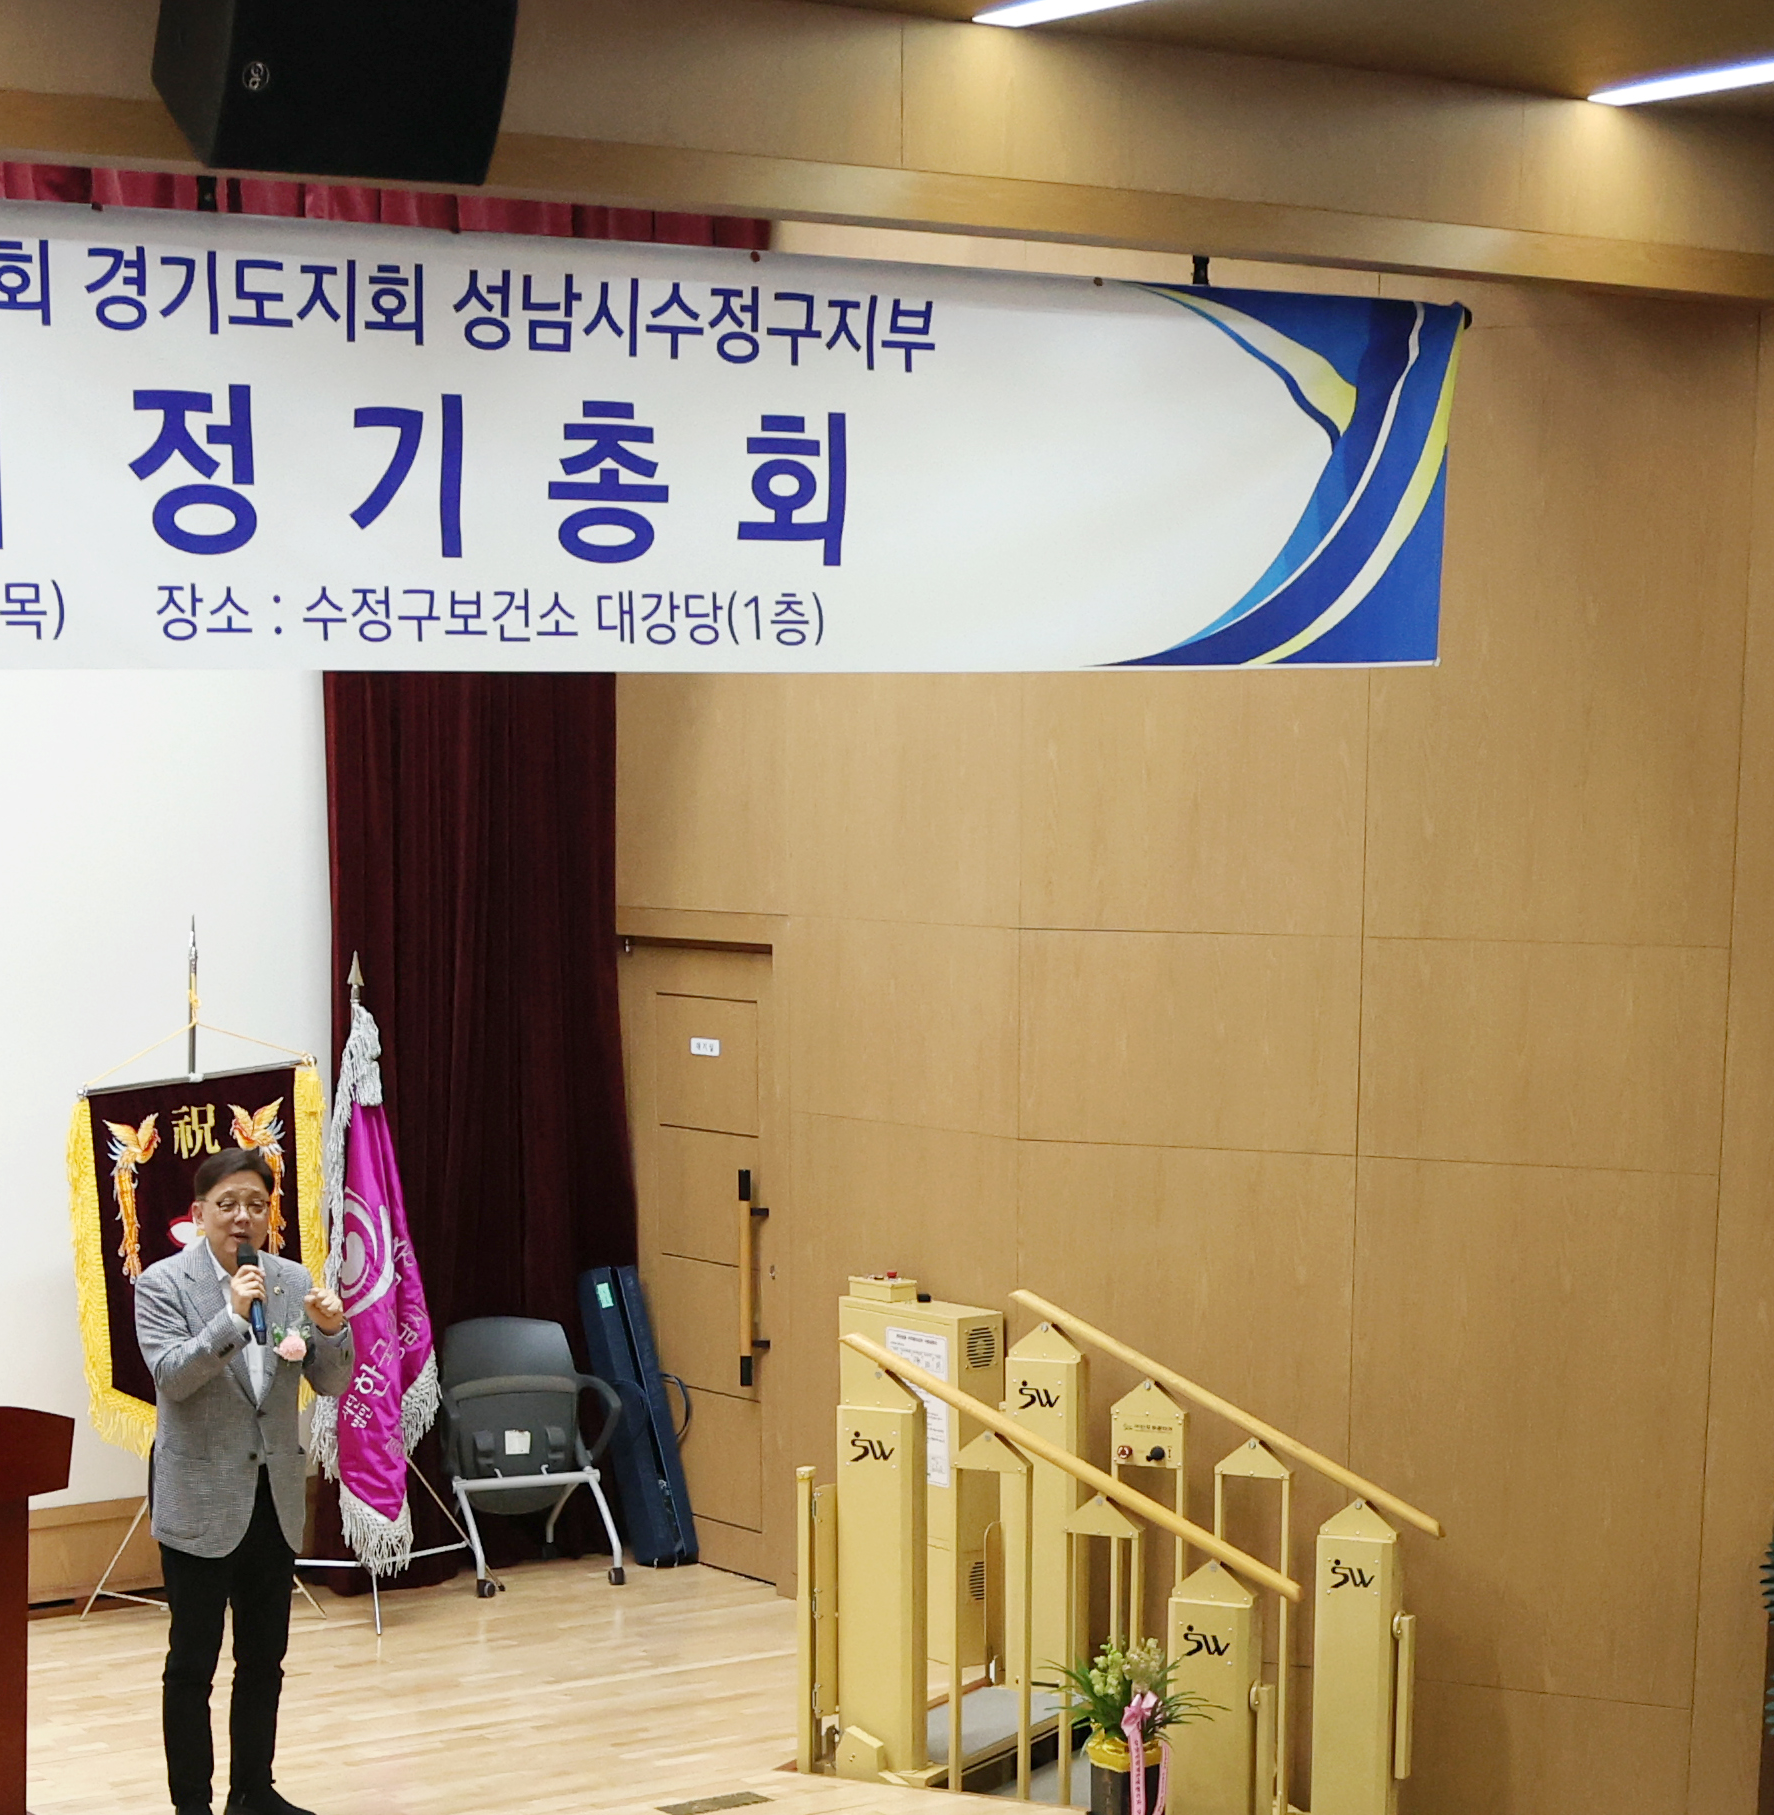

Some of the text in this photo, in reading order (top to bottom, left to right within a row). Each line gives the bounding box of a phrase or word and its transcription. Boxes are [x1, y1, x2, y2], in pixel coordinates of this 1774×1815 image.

[85, 245, 424, 345] 경기도지회
[453, 269, 937, 373] 성남시수정구지부
[303, 586, 578, 643] 수정구보건소
[597, 591, 824, 647] 대강당(1층)
[171, 1103, 221, 1160] 祝
